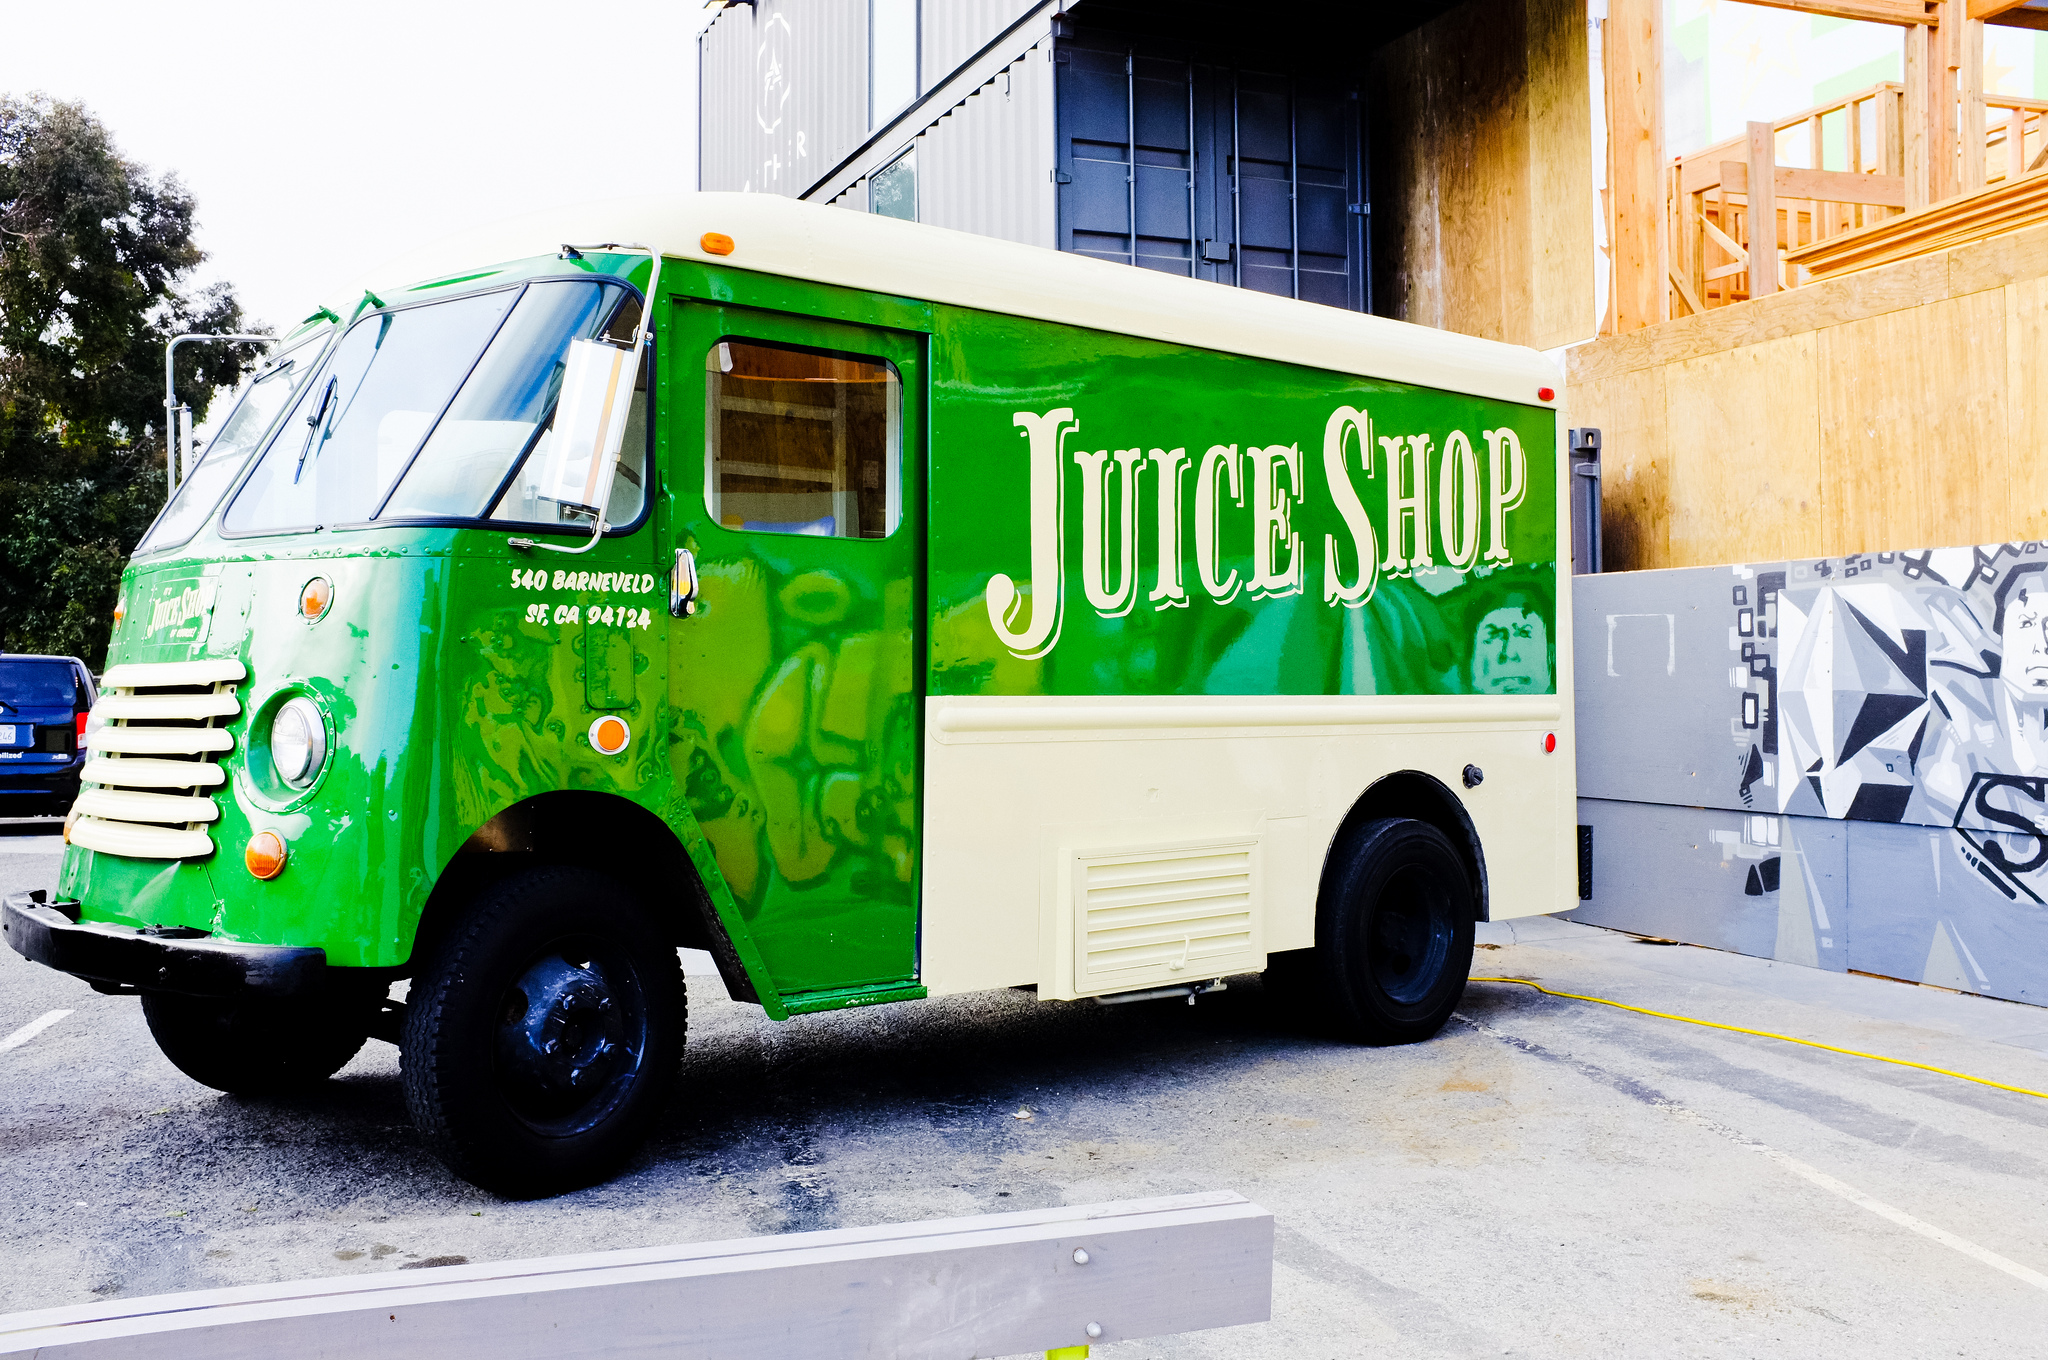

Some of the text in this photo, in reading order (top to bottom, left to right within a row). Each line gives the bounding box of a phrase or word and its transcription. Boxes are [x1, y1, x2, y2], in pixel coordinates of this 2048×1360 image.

[986, 406, 1527, 661] JUICE SHOP
[510, 568, 655, 594] 540 BARNEVELD
[525, 603, 652, 631] SF, CA 94124
